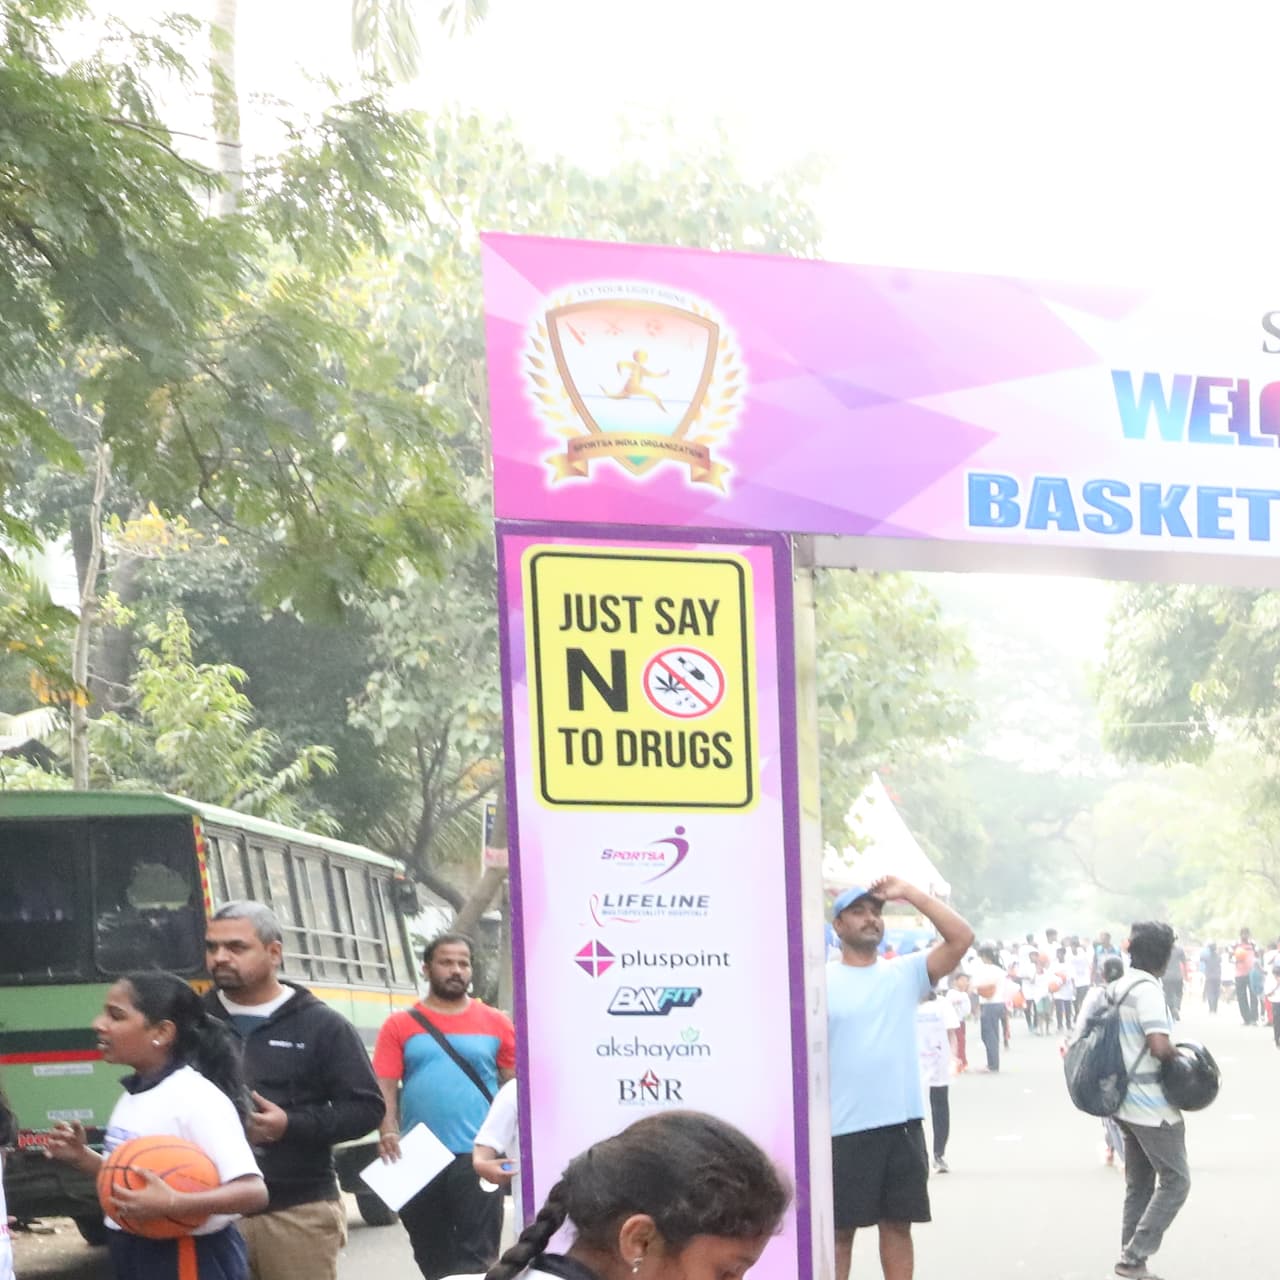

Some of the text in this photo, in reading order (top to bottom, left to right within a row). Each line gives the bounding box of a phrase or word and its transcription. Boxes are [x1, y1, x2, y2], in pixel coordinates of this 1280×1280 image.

[559, 593, 720, 636] JUST SAY
[558, 728, 733, 769] TO DRUGS
[603, 894, 711, 909] LIFELINE
[622, 950, 731, 969] pluspoint
[607, 986, 703, 1016] BAYFIT
[596, 1036, 711, 1061] akshayam
[618, 1078, 683, 1101] BNR
